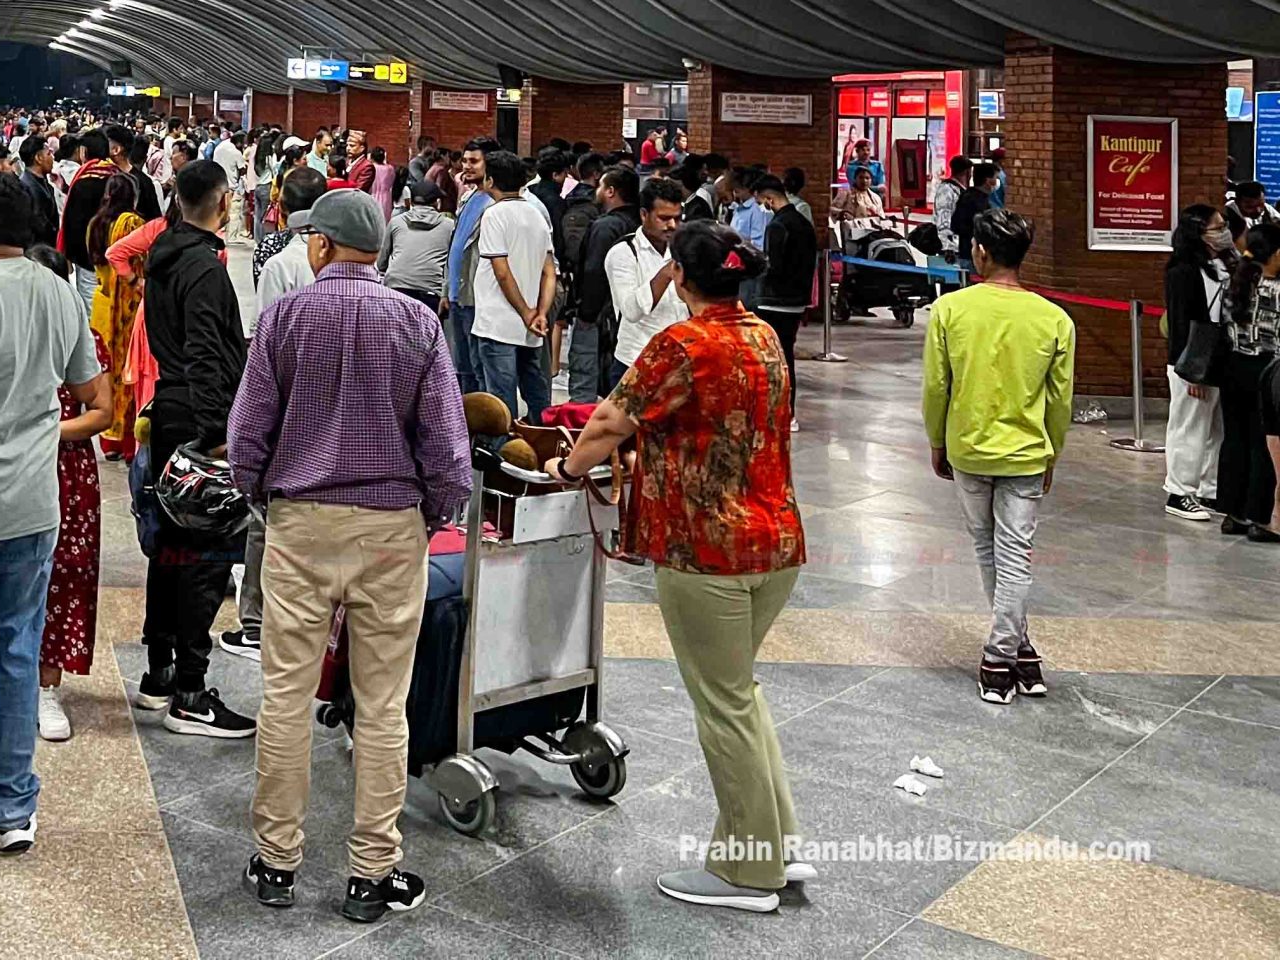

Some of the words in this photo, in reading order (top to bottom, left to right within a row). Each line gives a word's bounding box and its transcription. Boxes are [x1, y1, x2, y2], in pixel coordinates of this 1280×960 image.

[1101, 135, 1162, 154] Kantipur
[1108, 153, 1154, 187] Cafe
[1112, 192, 1145, 200] Delicious
